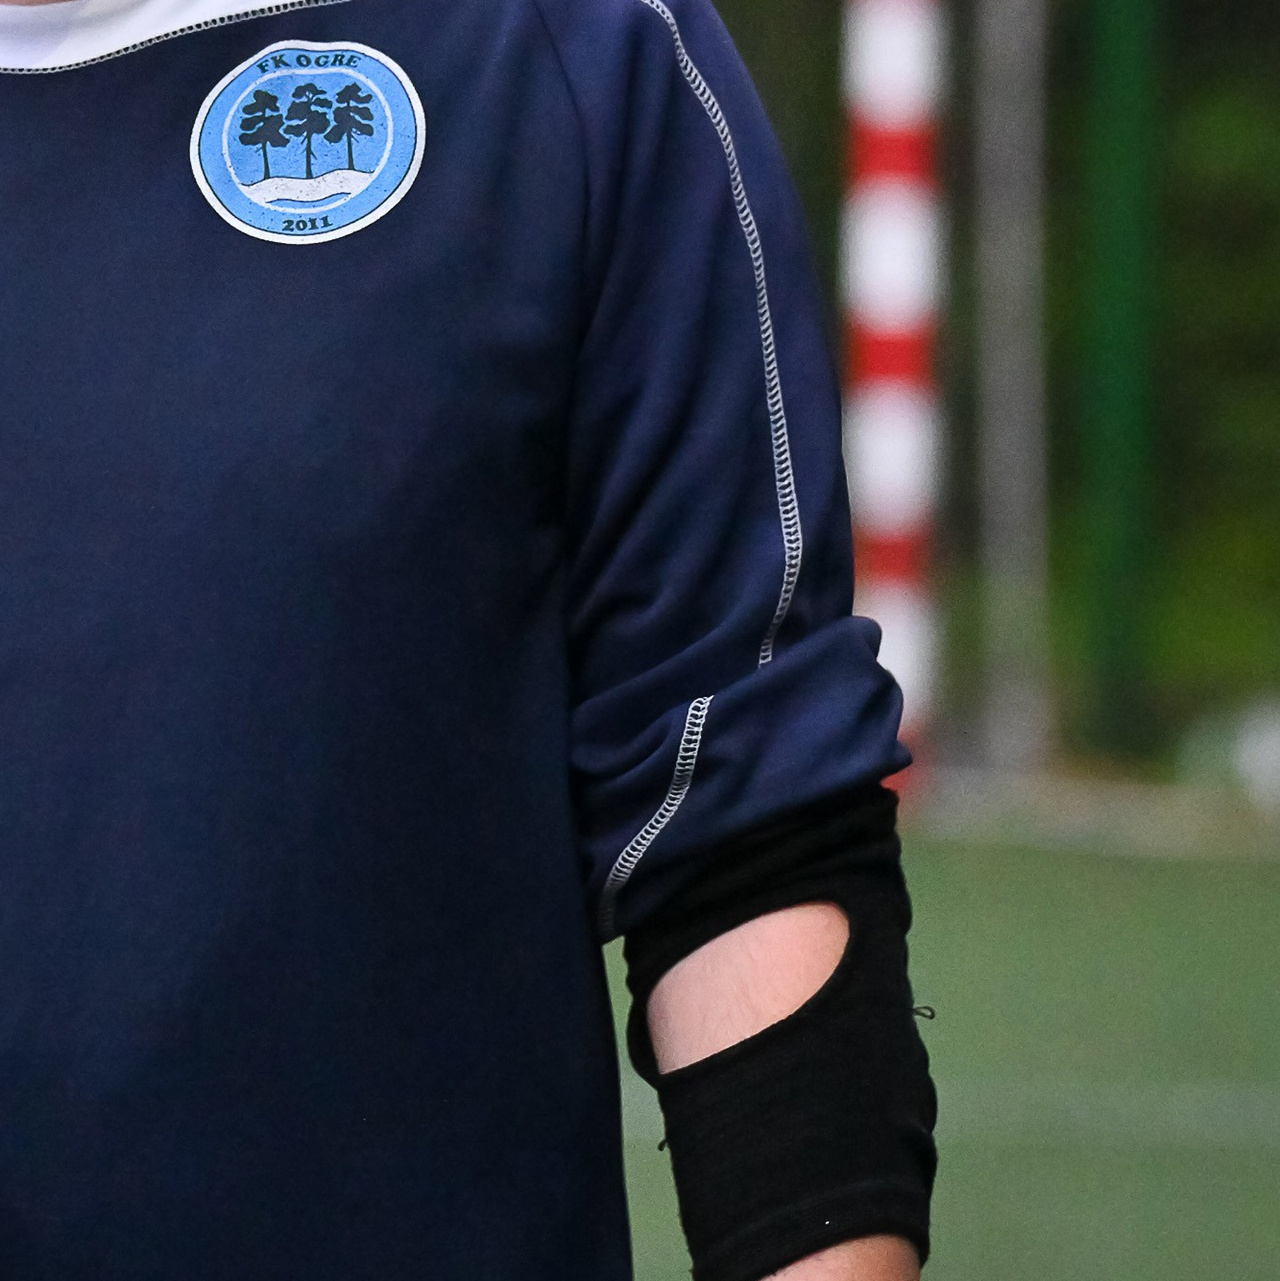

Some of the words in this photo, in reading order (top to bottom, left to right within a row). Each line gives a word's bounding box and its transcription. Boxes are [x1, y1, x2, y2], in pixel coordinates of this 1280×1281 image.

[257, 54, 290, 73] FK
[296, 54, 361, 68] OGRE
[282, 216, 333, 232] 2011
